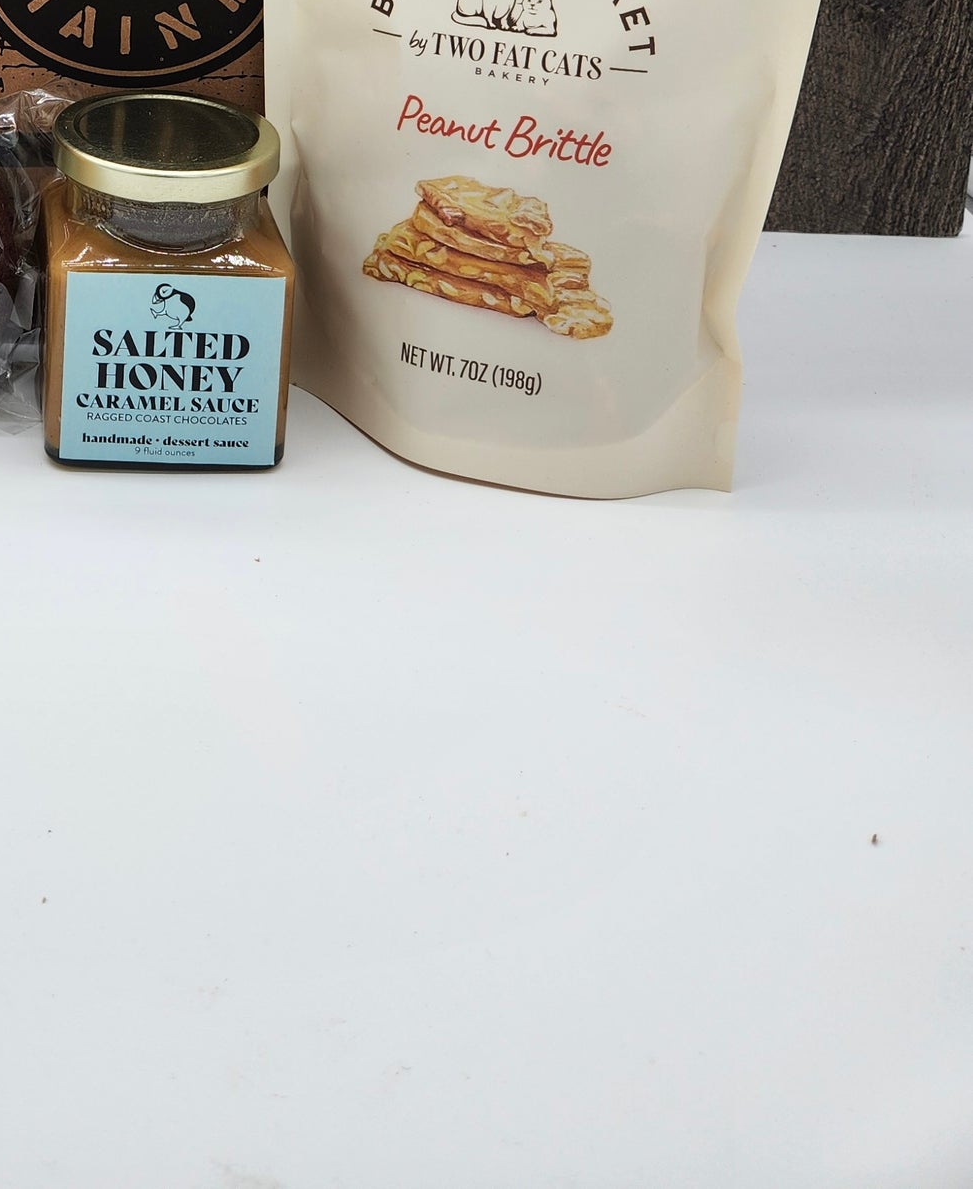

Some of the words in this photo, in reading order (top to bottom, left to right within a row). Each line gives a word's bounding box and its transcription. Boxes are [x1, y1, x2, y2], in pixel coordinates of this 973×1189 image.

[409, 30, 428, 56] by
[432, 32, 486, 62] TWO
[491, 41, 537, 69] FAT
[540, 49, 603, 80] CATS
[475, 67, 550, 85] BAKERY
[396, 94, 501, 149] Peanut
[504, 115, 613, 167] Brittle
[92, 329, 250, 360] SALTED
[94, 362, 244, 392] HONEY
[400, 342, 427, 368] NET
[430, 351, 455, 377] WT.
[492, 365, 542, 396] (198g)
[76, 393, 185, 411] CARAMEL
[191, 397, 259, 413] SAUCE
[87, 413, 133, 422] RAGGED
[135, 414, 171, 423] COAST
[174, 416, 247, 426] CHOCOLATES
[82, 433, 152, 446] handmade
[163, 436, 210, 447] dessert
[213, 438, 249, 448] sauce
[143, 447, 163, 456] fluid
[165, 449, 195, 457] ounces
